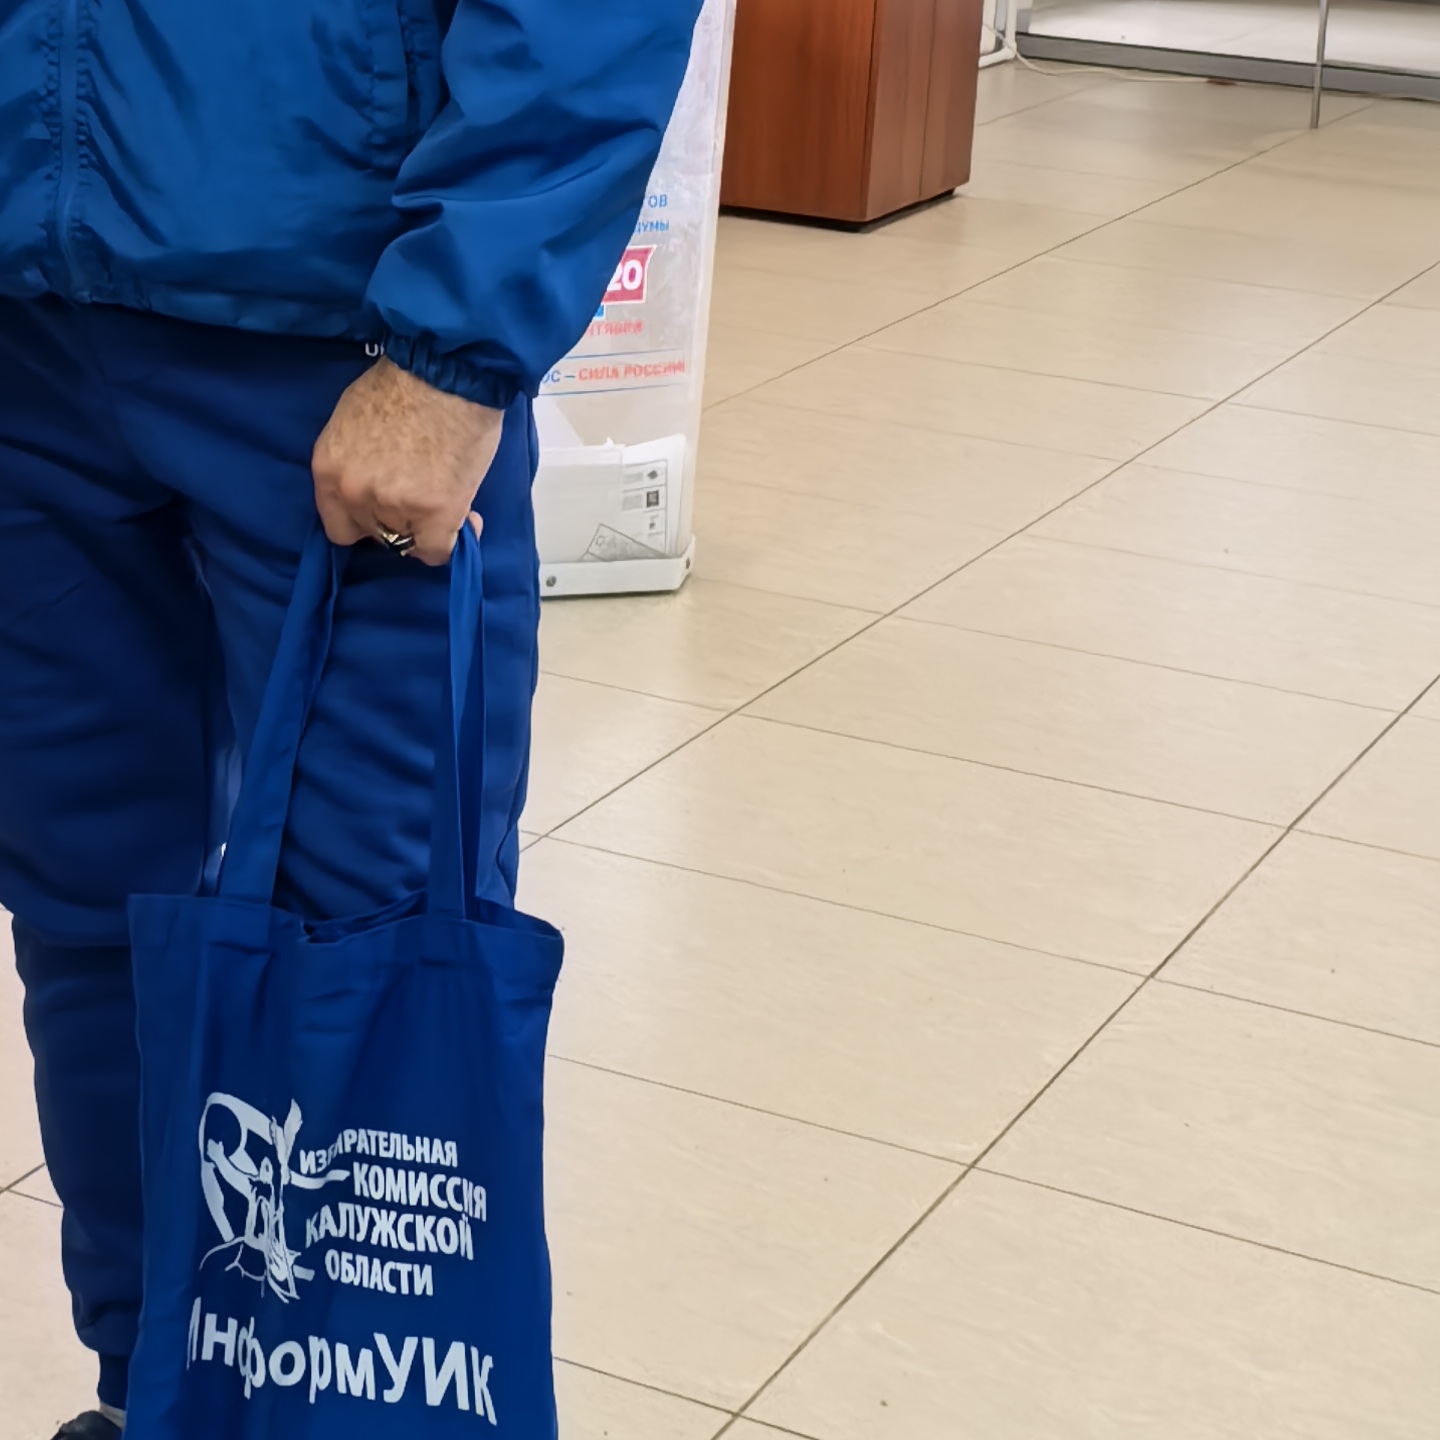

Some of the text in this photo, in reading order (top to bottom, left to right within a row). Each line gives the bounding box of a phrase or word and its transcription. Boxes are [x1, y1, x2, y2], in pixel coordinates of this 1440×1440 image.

[299, 1128, 458, 1175] ИЗБИРАТЕЛЬНАЯ
[353, 1162, 487, 1222] КОМИССИЯ
[305, 1202, 474, 1260] КАЛУЖСКОЙ
[324, 1249, 434, 1296] ОБЛАСТИ
